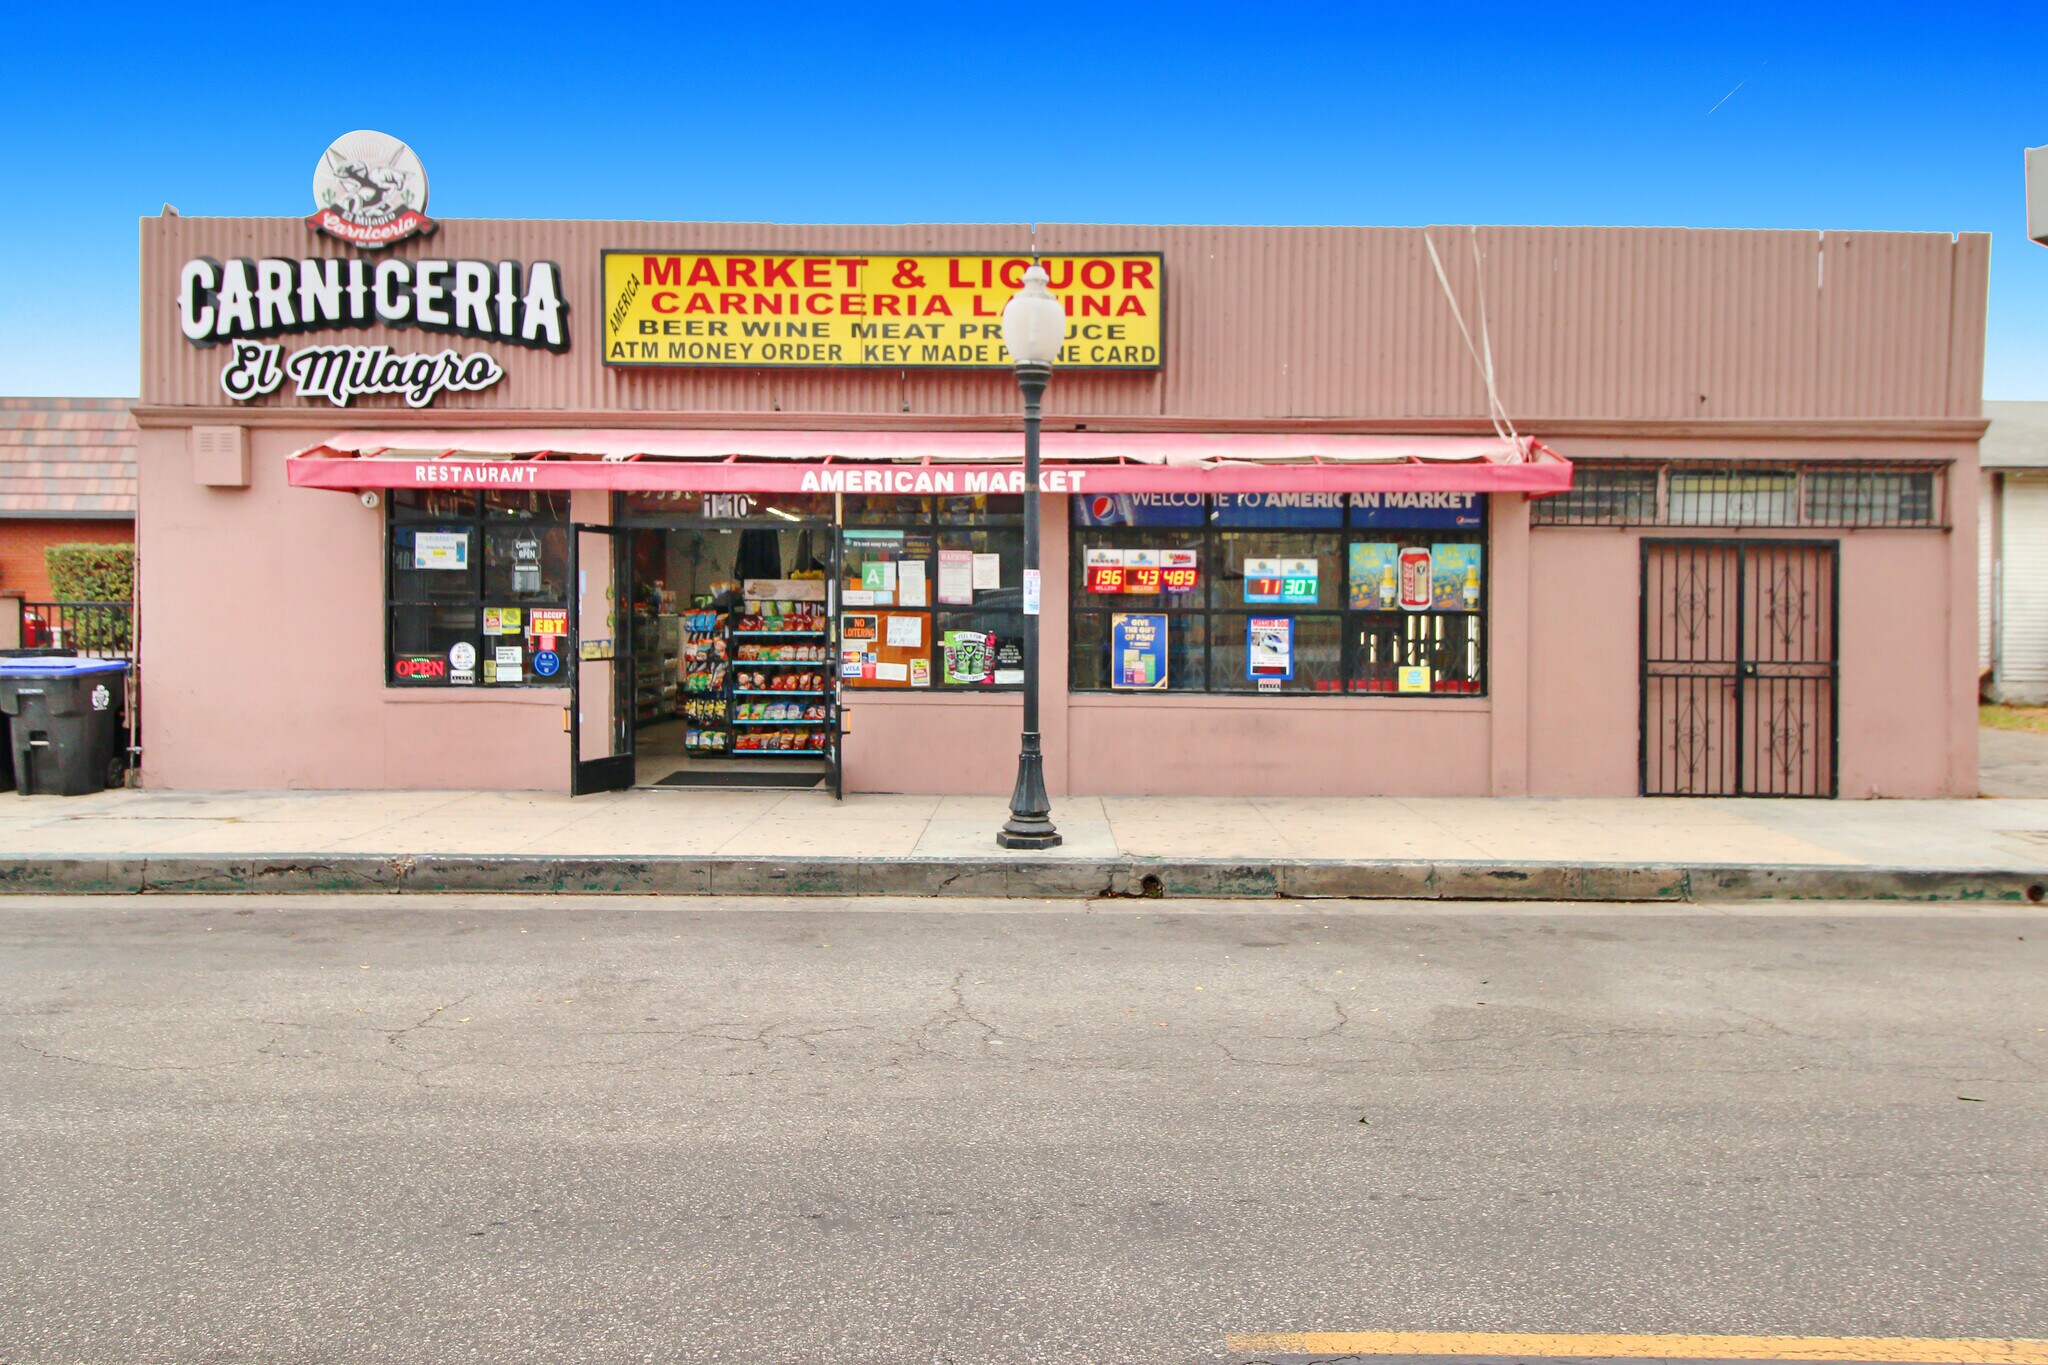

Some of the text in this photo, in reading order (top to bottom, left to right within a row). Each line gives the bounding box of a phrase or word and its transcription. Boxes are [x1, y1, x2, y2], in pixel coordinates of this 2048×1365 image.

[323, 212, 417, 240] Carniceria
[643, 257, 1155, 290] MARKET & LIQUOR
[177, 258, 562, 345] CARNICERIA
[609, 272, 641, 337] AMERICA
[651, 291, 1147, 317] CARNICERIA LINA
[639, 320, 1126, 341] BEER WINE MEAT PRUCE
[610, 341, 659, 359] ATM
[669, 342, 754, 361] MONEY
[761, 343, 843, 362] ORDER
[864, 344, 912, 362] KEY
[921, 344, 988, 362] MADE
[1090, 345, 1156, 364] CARD
[221, 341, 502, 406] El Milagro
[415, 465, 538, 483] RESTAURANT
[801, 470, 955, 492] AMERICAN
[1265, 492, 1380, 508] AMERICAN
[1384, 492, 1476, 509] MARKET
[866, 568, 880, 584] A
[1096, 570, 1122, 585] 196
[1137, 570, 1159, 585] 43
[1163, 570, 1196, 585] 489
[1260, 579, 1280, 594] 71
[1284, 579, 1317, 595] 307
[543, 611, 567, 619] ACCEPT
[854, 618, 865, 627] NO
[535, 619, 564, 633] EBT
[844, 627, 875, 637] LOITERING
[395, 659, 445, 676] OPEN
